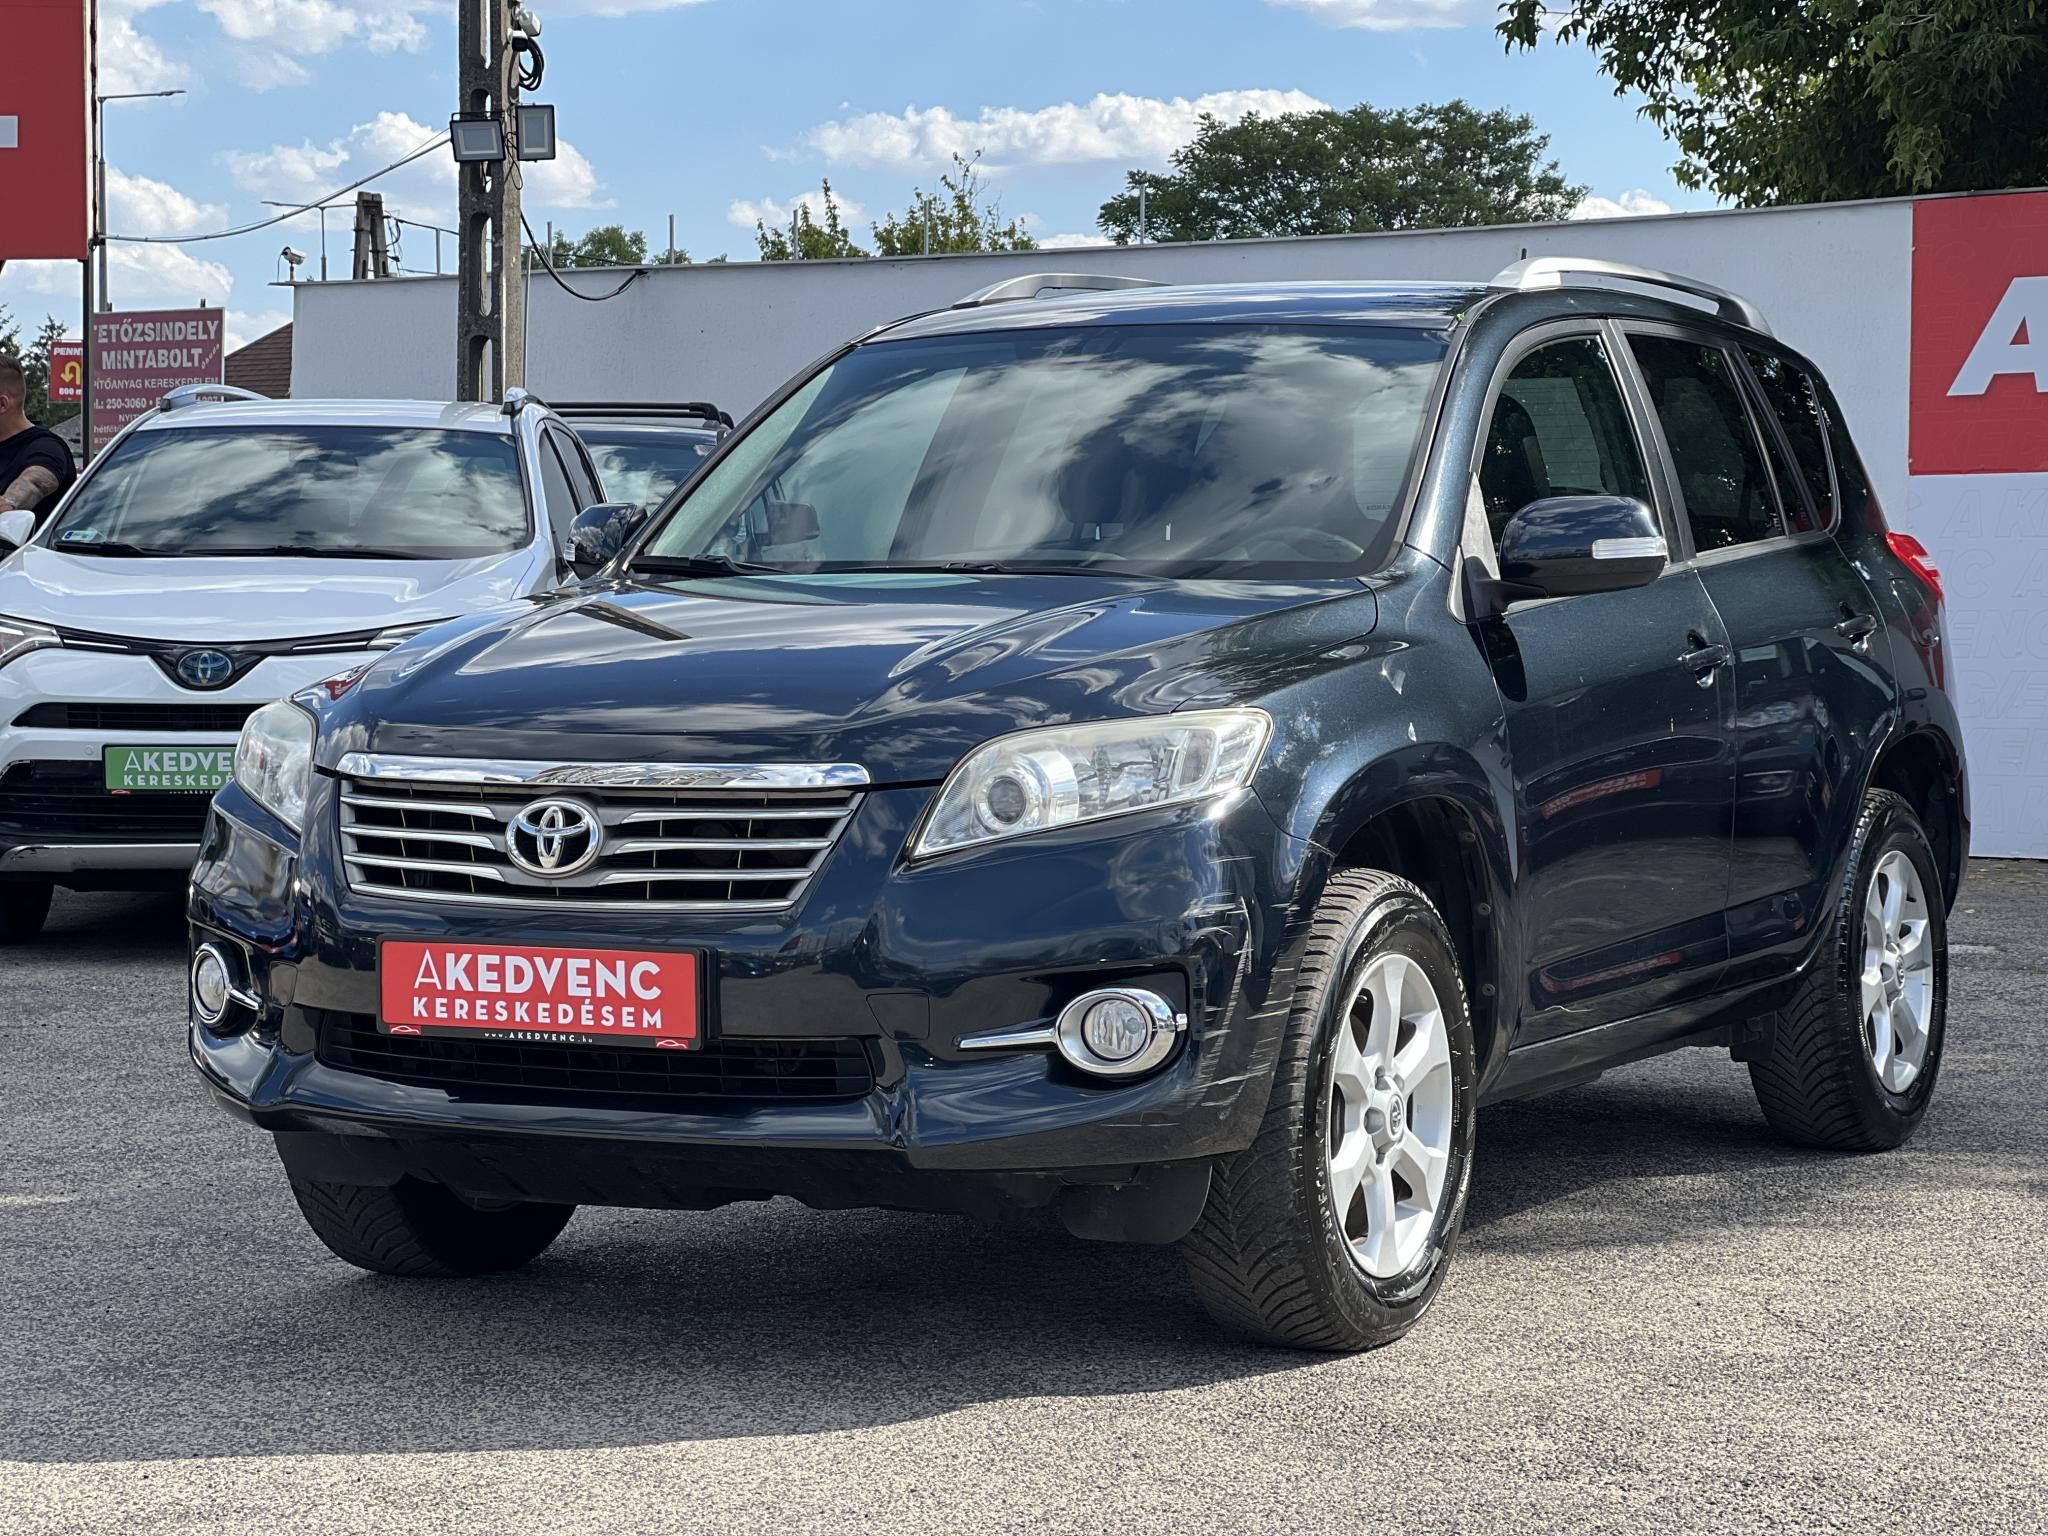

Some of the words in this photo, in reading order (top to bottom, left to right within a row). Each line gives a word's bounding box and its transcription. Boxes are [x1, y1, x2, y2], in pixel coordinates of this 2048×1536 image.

[94, 318, 219, 343] ETŐZSINDELY
[102, 347, 202, 370] MINTABOLT
[106, 397, 147, 409] 250-3060
[413, 949, 662, 1000] AKEDVENC
[413, 997, 663, 1029] KERESKEDÉSEM
[484, 1031, 593, 1043] www.AKEDVENC.hu
